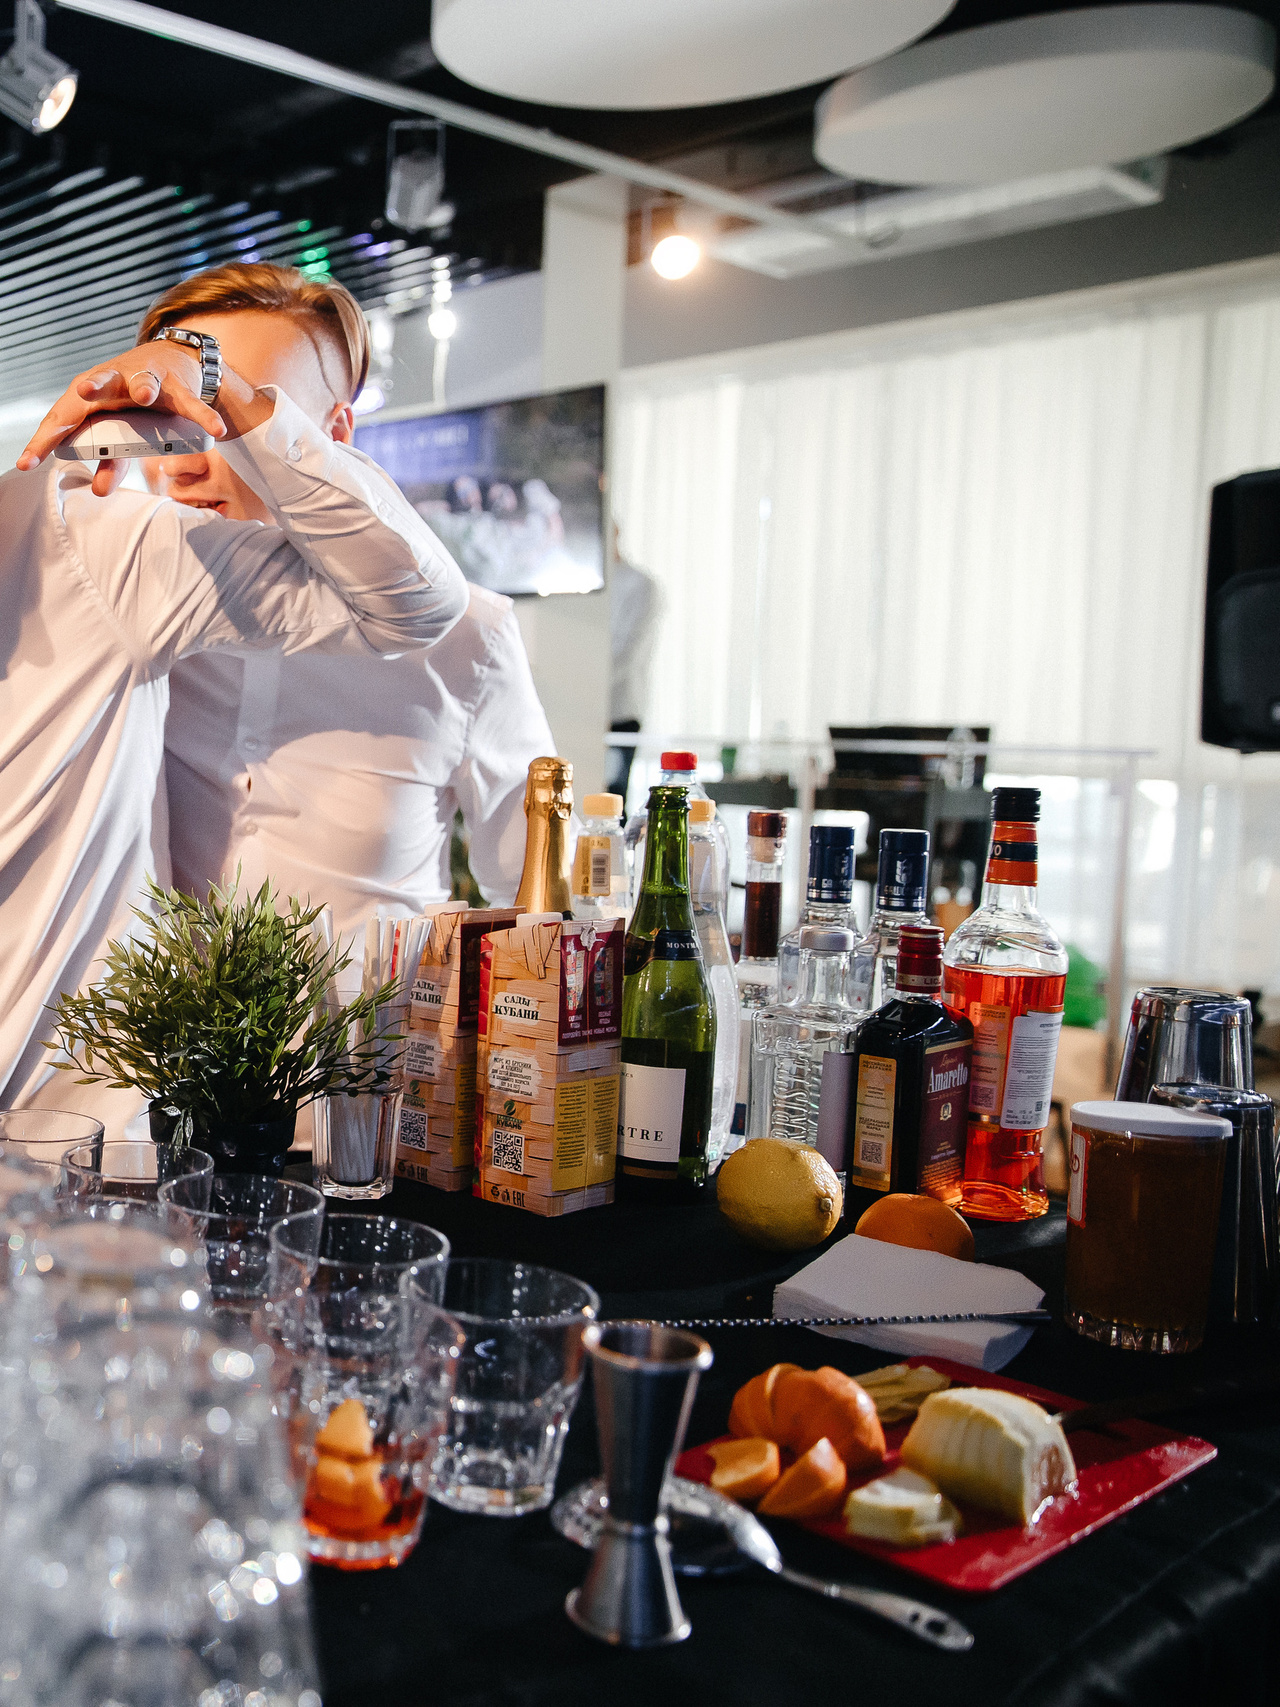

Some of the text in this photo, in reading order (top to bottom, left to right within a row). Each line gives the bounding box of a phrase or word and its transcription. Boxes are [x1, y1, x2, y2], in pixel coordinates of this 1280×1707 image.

[415, 980, 435, 992] АДЫ
[410, 990, 442, 1005] УБАНИ
[504, 995, 531, 1007] САДЫ
[494, 1004, 539, 1021] КУБАНИ
[927, 1062, 969, 1094] Amaretto
